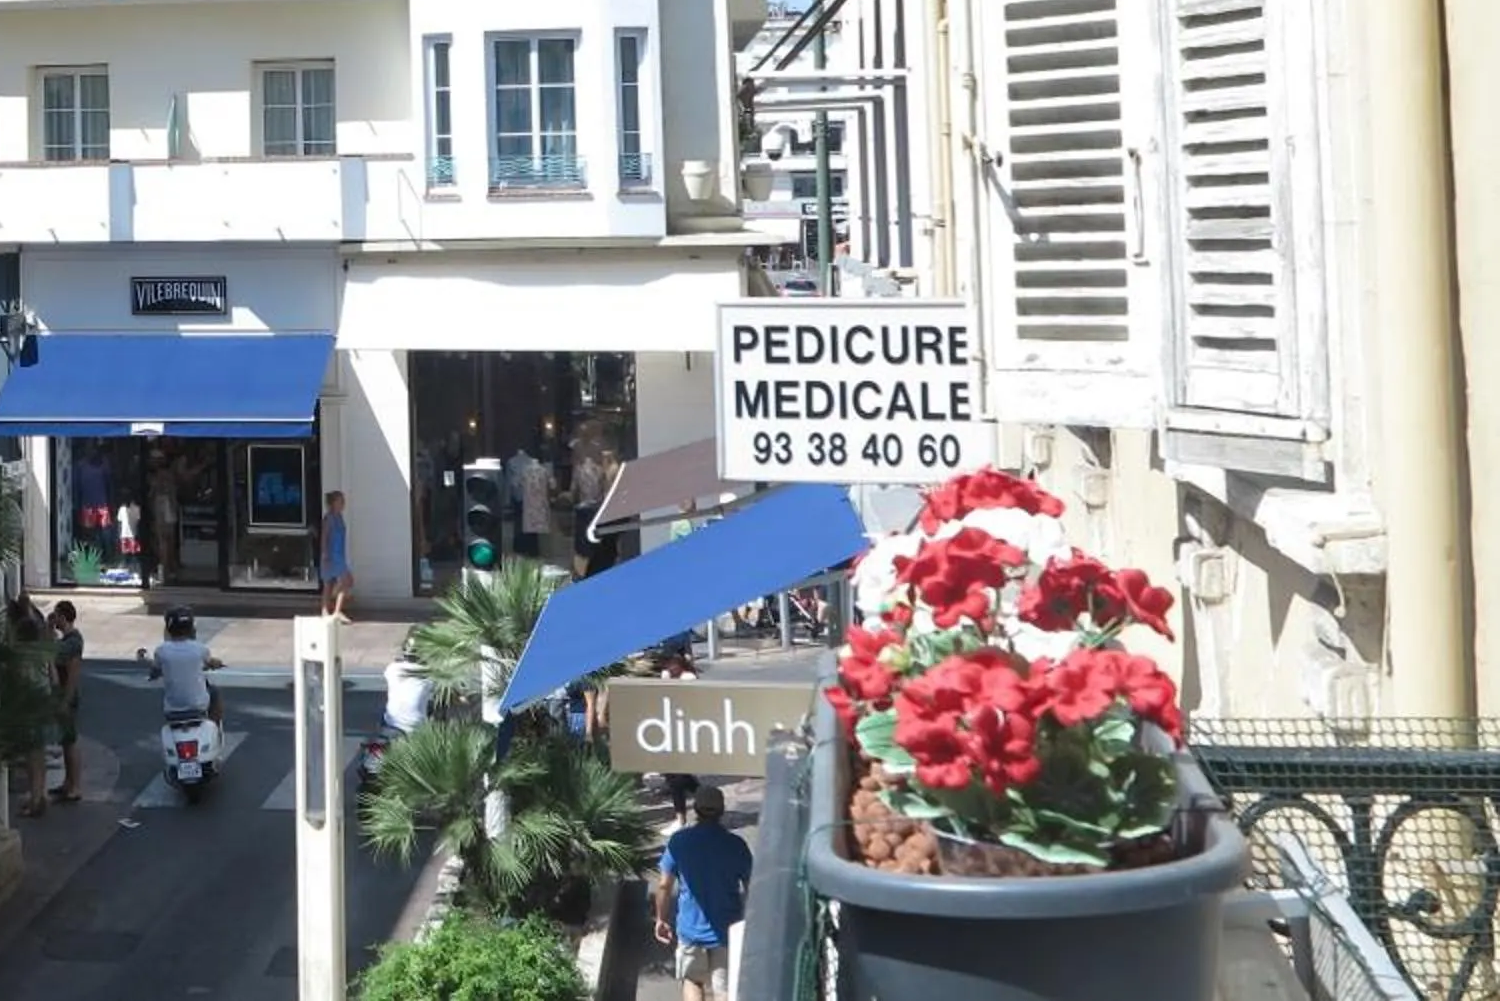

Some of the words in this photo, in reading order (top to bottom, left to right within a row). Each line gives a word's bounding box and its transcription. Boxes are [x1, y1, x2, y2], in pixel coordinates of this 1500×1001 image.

[136, 281, 221, 310] VILEBREQUIN
[732, 324, 968, 365] PEDICURE
[735, 380, 971, 421] MEDICALE
[753, 431, 792, 465] 93
[808, 432, 848, 466] 38
[861, 432, 902, 466] 40
[918, 434, 961, 468] 60
[636, 696, 756, 756] dinh
